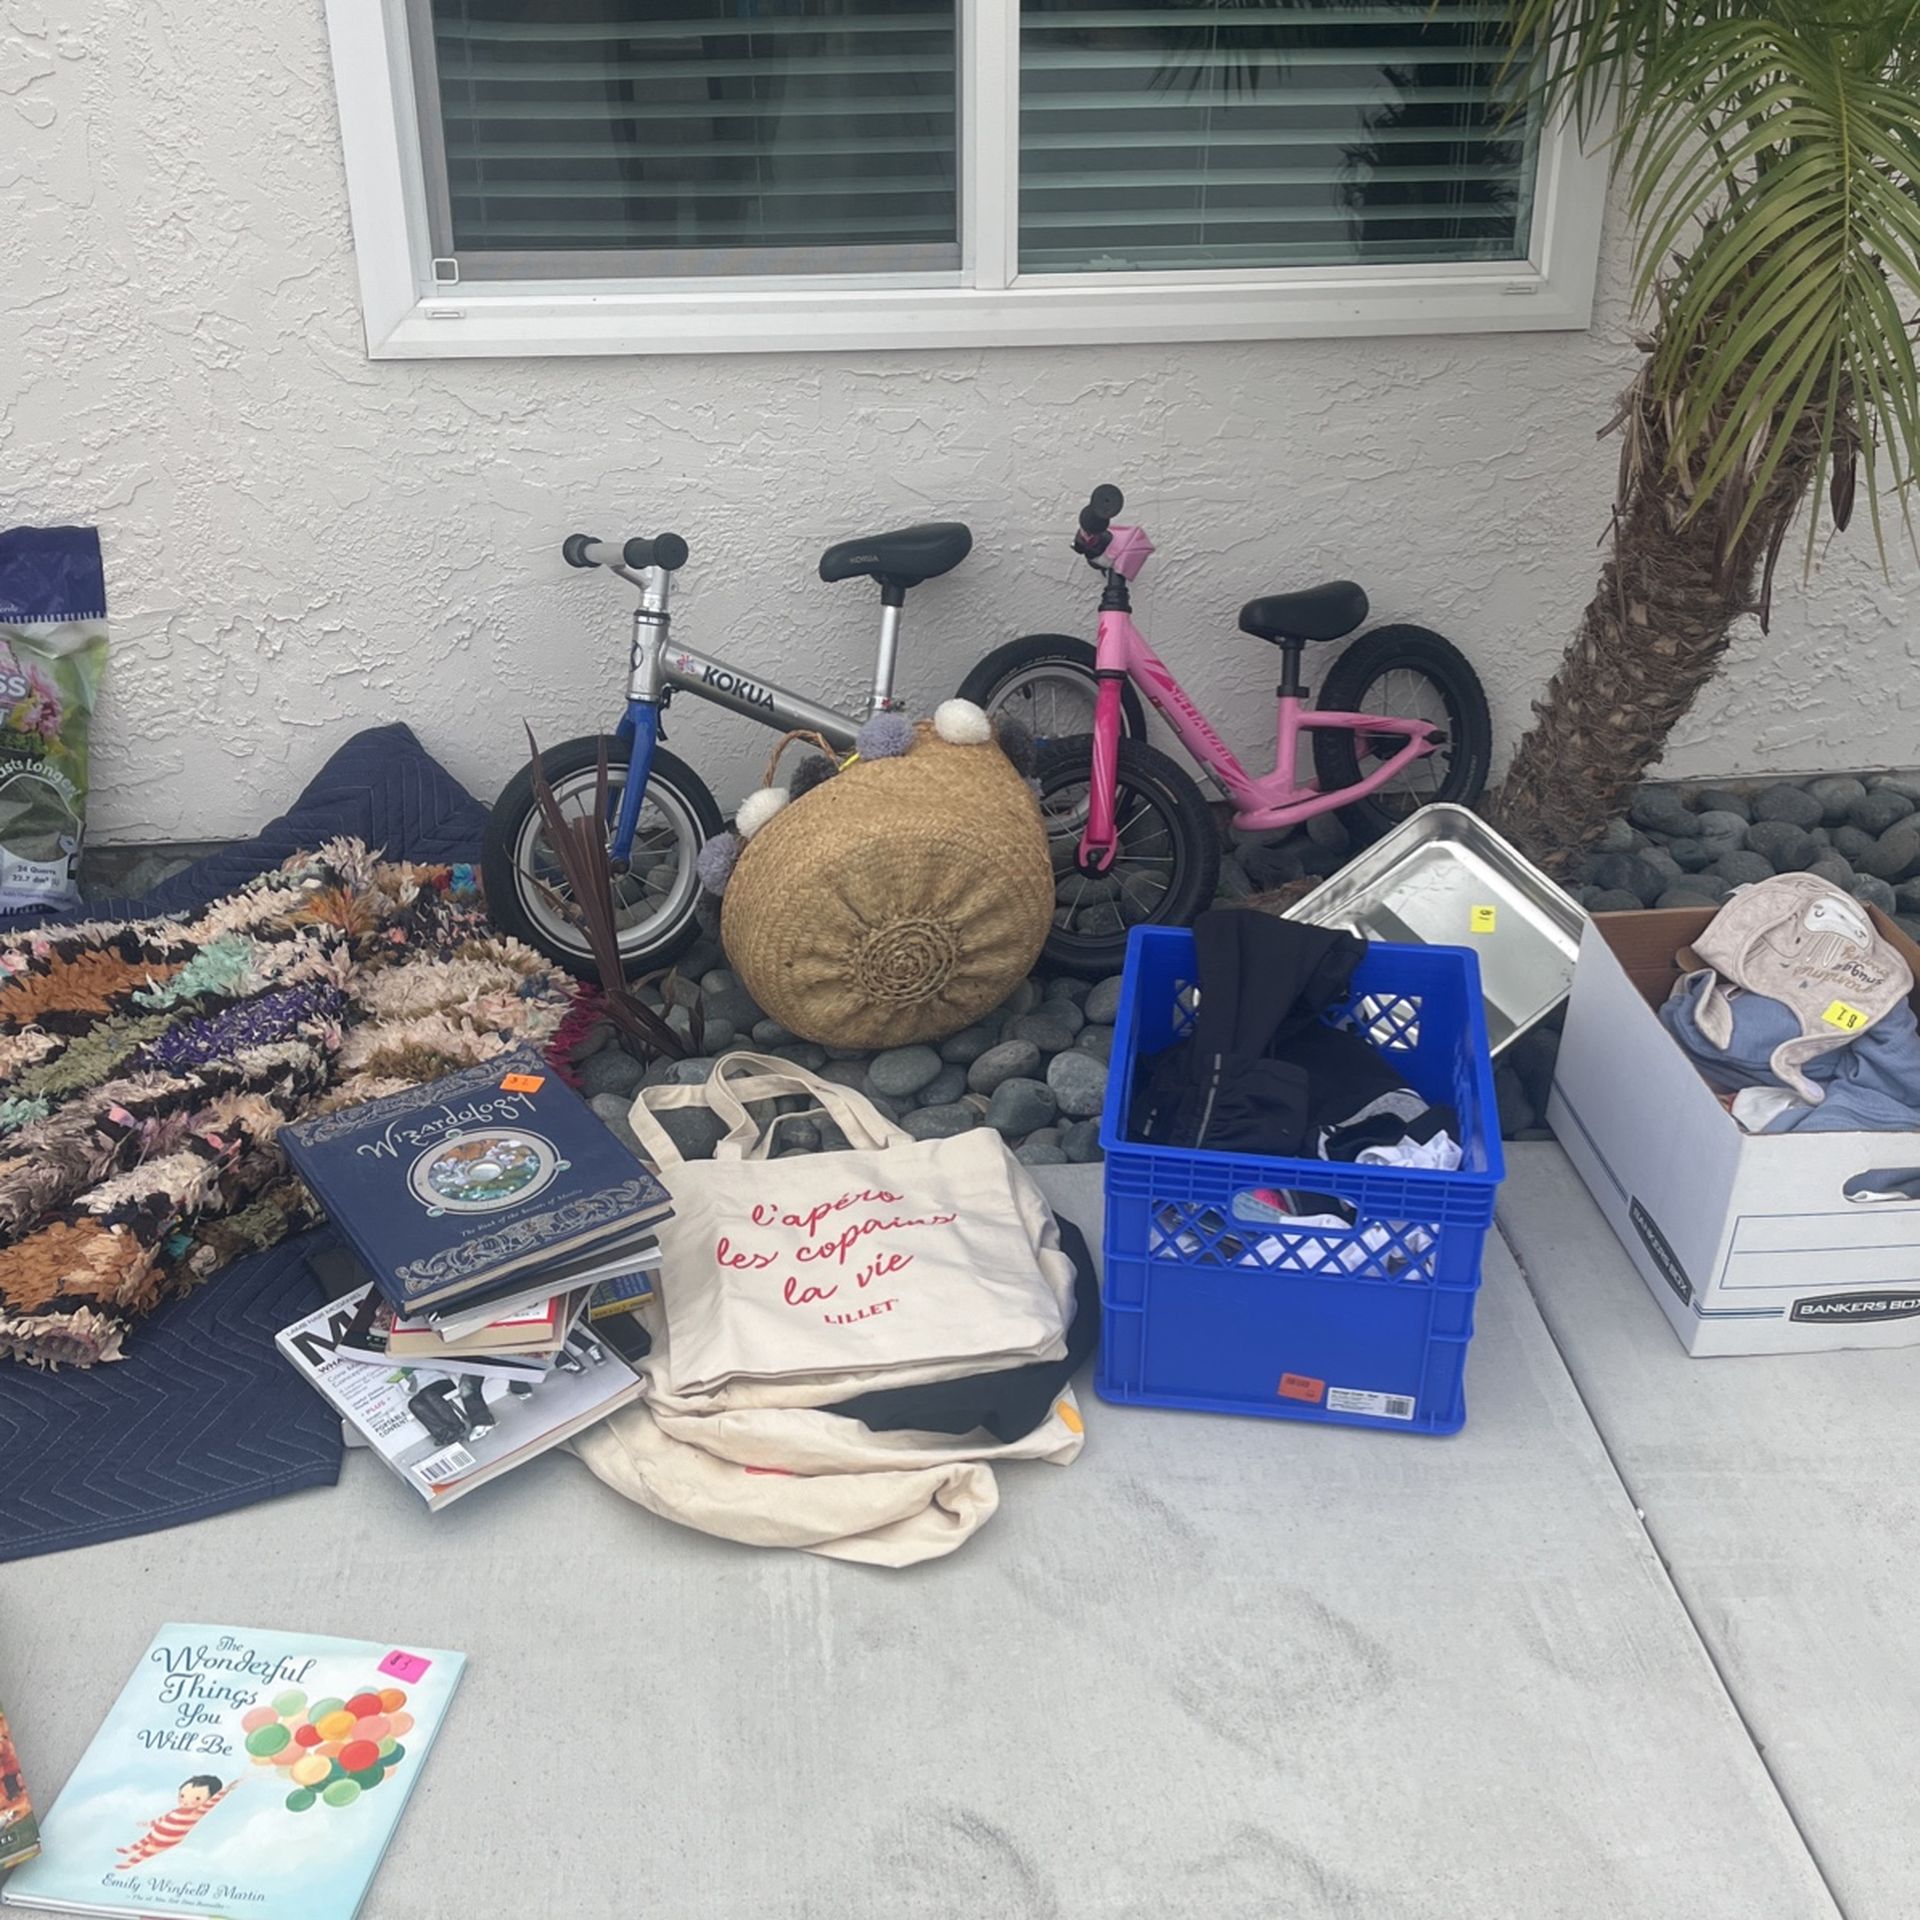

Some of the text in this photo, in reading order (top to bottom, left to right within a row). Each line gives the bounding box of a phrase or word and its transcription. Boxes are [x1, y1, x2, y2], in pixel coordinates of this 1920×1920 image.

[702, 665, 775, 712] KOKUA
[357, 1092, 537, 1160] Wizardology
[716, 1213, 957, 1269] les copains
[1633, 1207, 1687, 1294] BANKERS BOX
[784, 1253, 914, 1305] la vie
[824, 1299, 899, 1325] LILLET
[1800, 1301, 1887, 1314] BANKERS
[151, 1643, 317, 1685] Wonderful
[216, 1635, 244, 1653] The
[158, 1671, 258, 1711] Things
[175, 1702, 222, 1729] You
[137, 1729, 234, 1757] Will Be
[101, 1872, 266, 1902] Emily Winfield Martin
